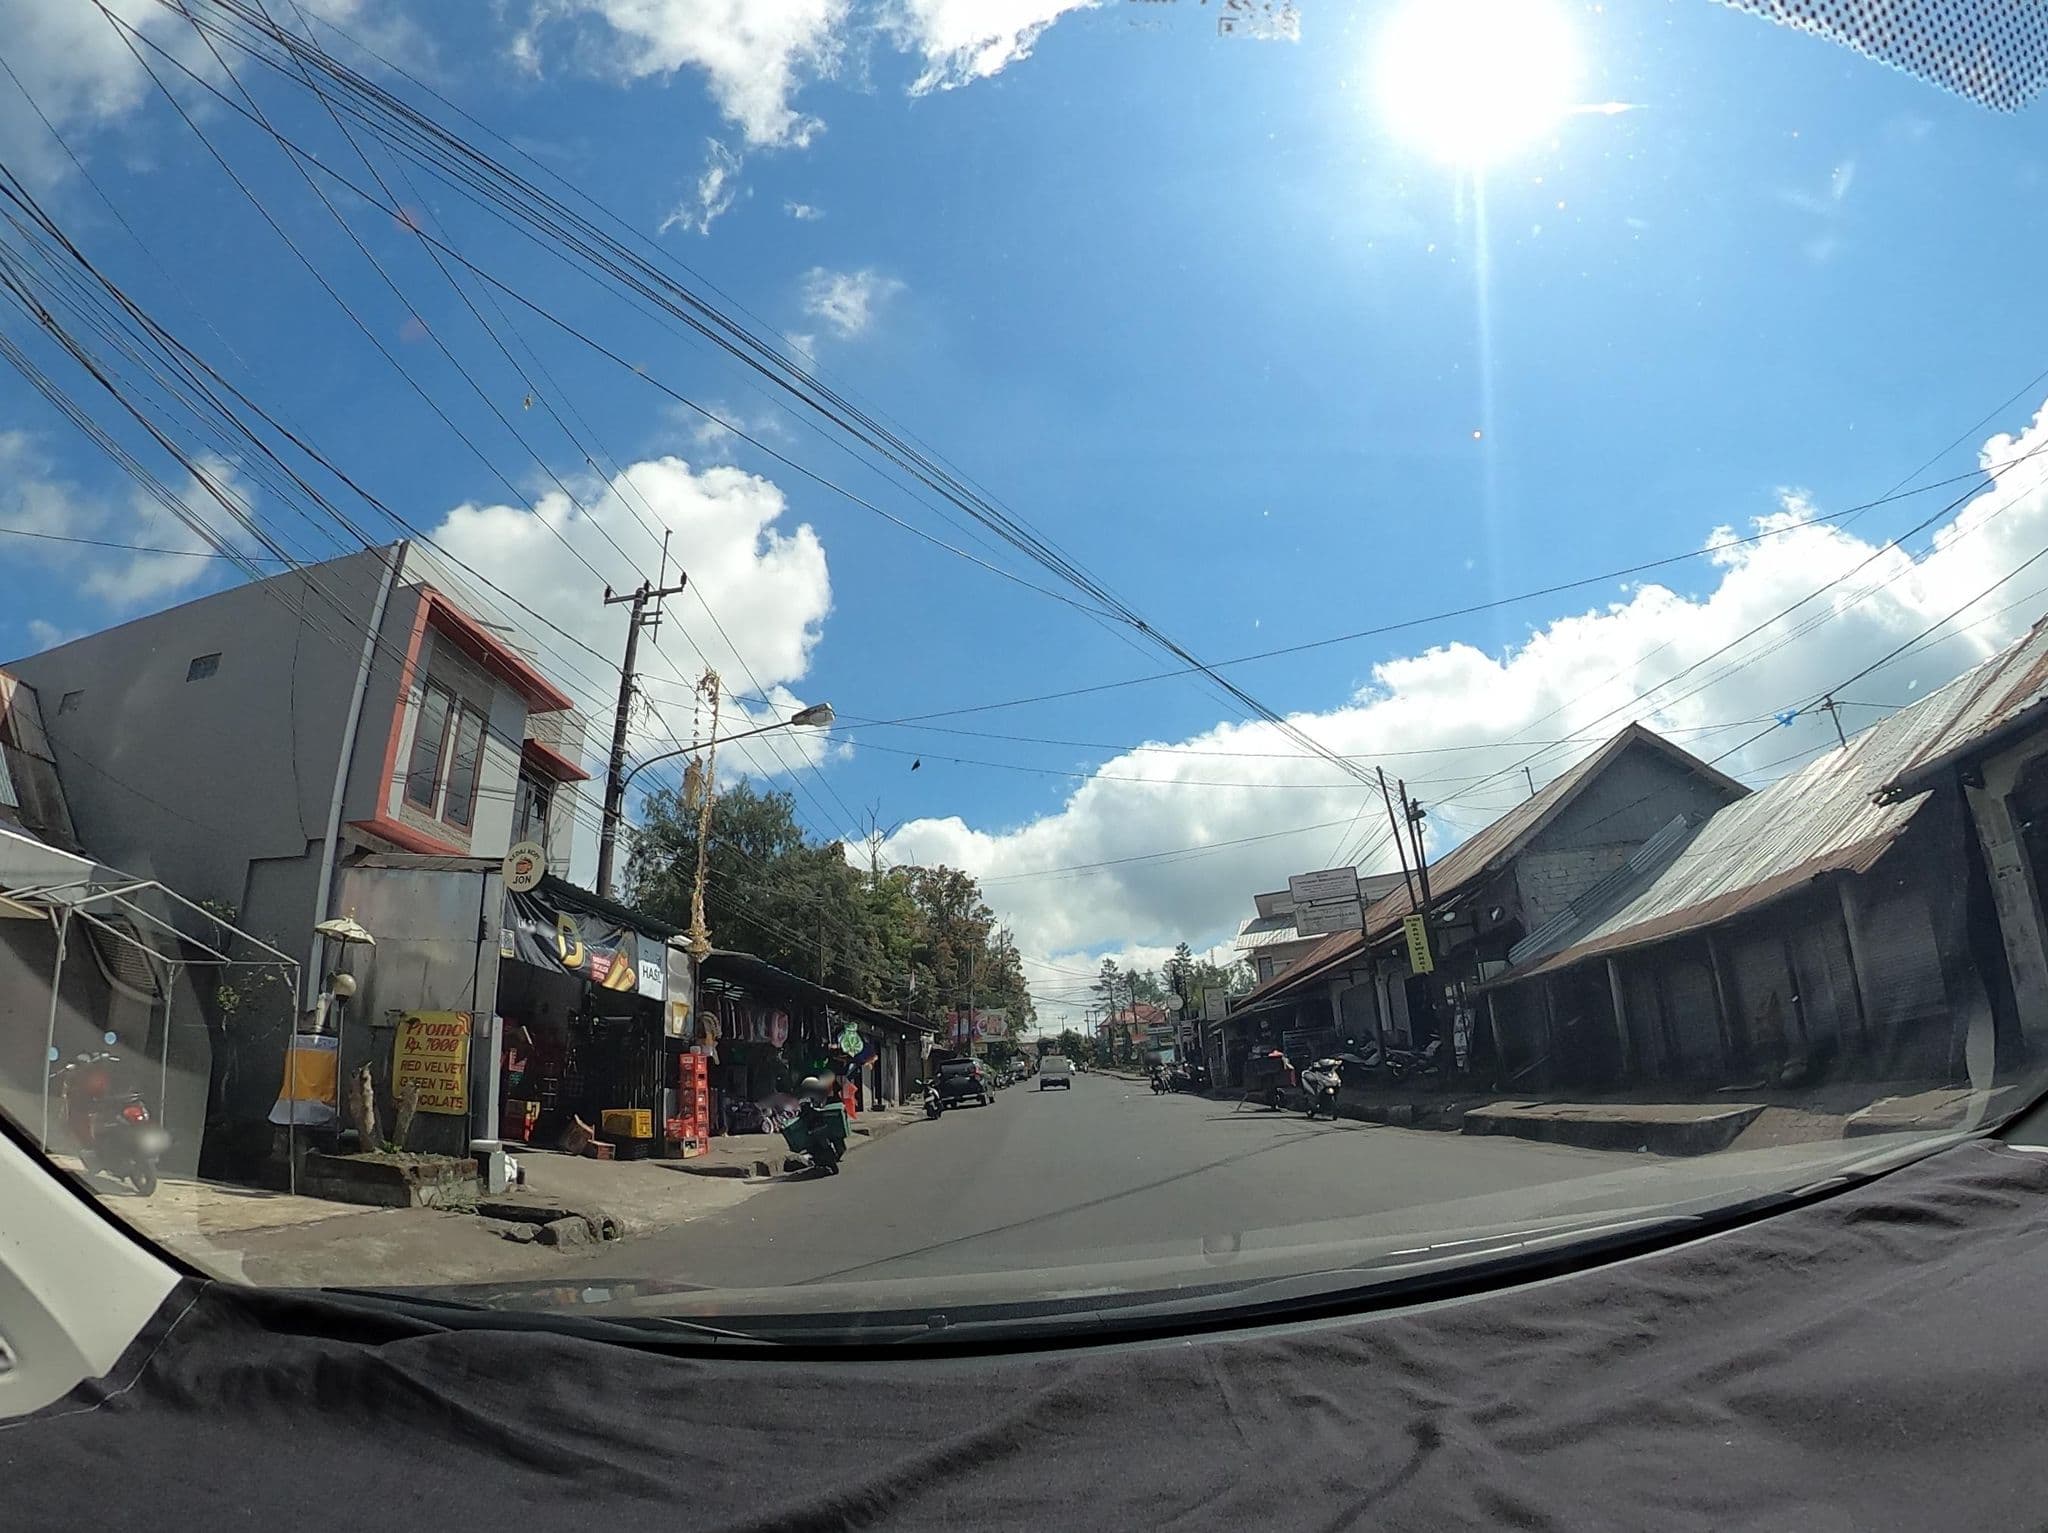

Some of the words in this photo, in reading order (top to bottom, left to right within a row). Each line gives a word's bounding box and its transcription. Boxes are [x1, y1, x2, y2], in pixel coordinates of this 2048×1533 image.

[512, 875, 532, 885] JON
[406, 1019, 465, 1037] Promo
[426, 1038, 459, 1052] 7000
[400, 1060, 421, 1072] RED
[424, 1061, 466, 1074] VELVET
[439, 1078, 461, 1091] TEA
